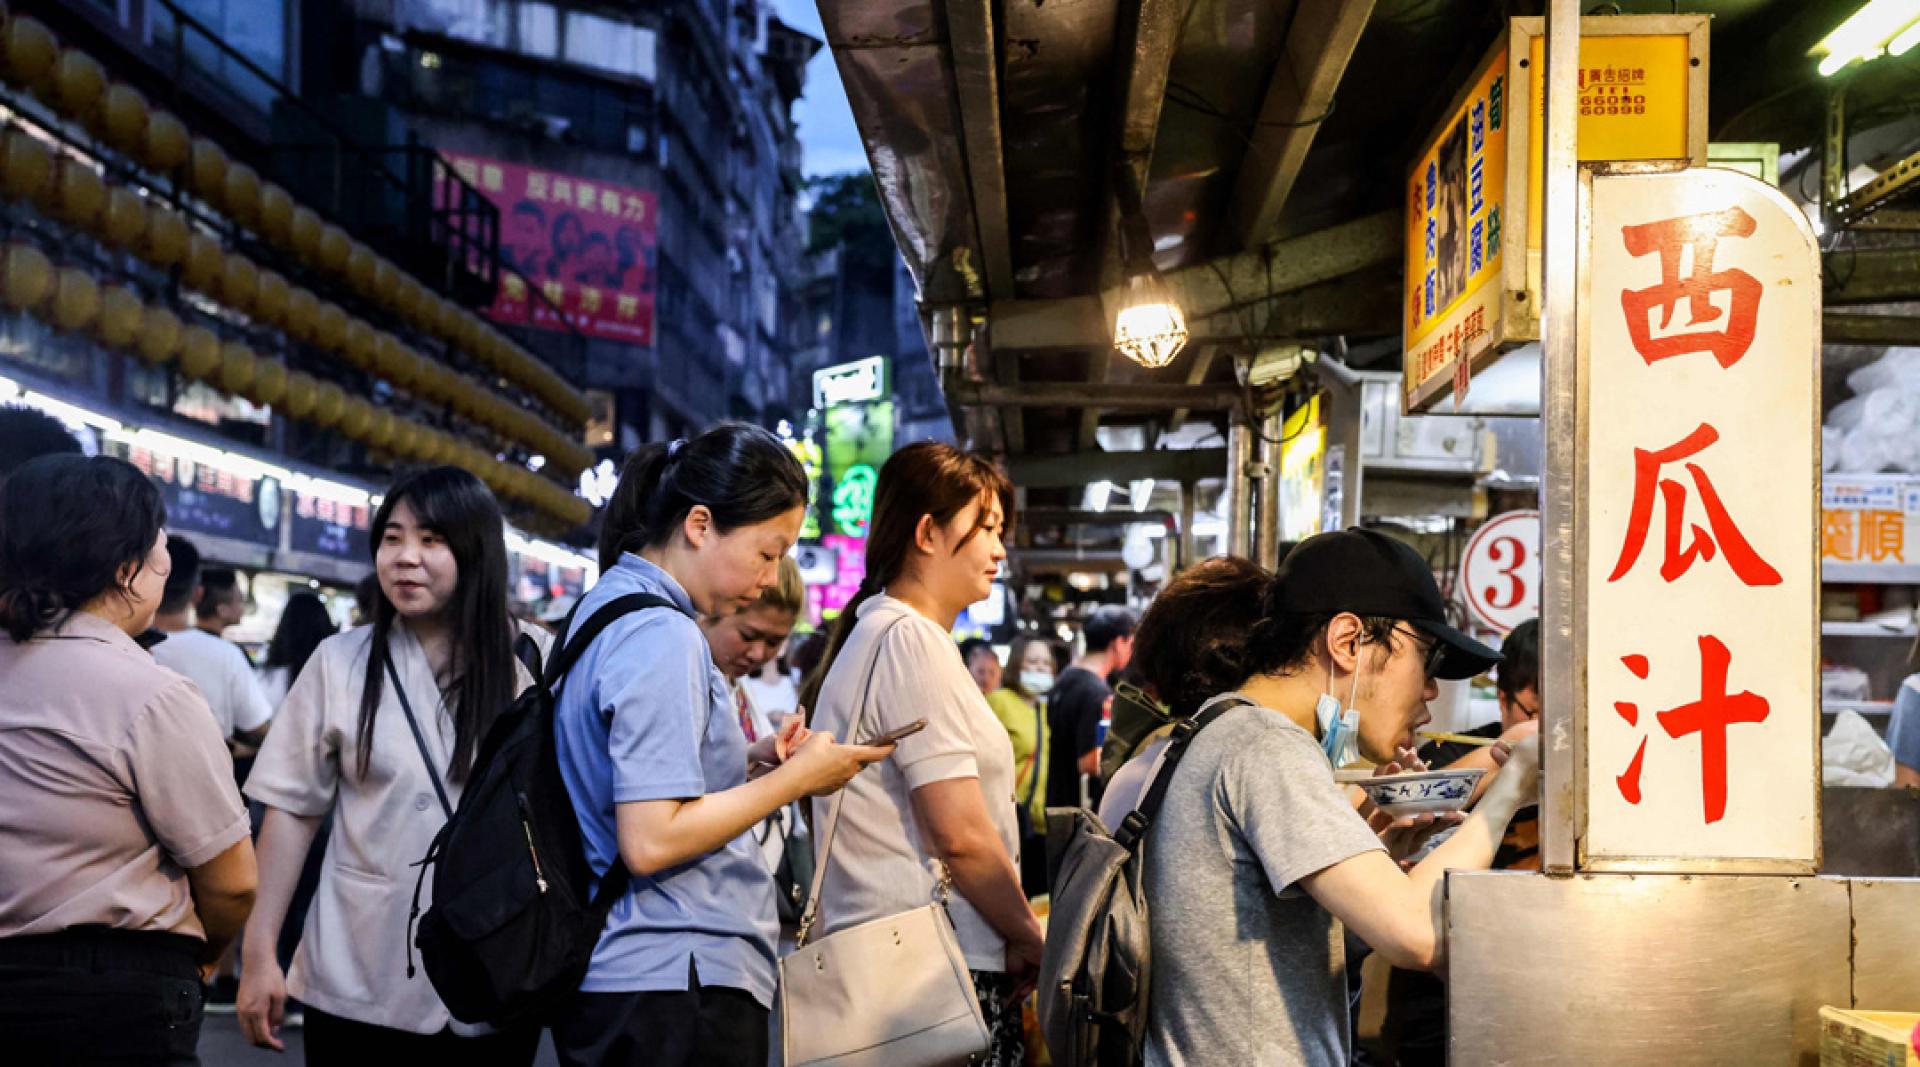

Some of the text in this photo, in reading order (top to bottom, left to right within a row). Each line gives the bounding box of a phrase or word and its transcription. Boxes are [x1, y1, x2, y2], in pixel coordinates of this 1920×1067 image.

[1484, 535, 1538, 609] 3
[1607, 205, 1784, 825] 西瓜汁
